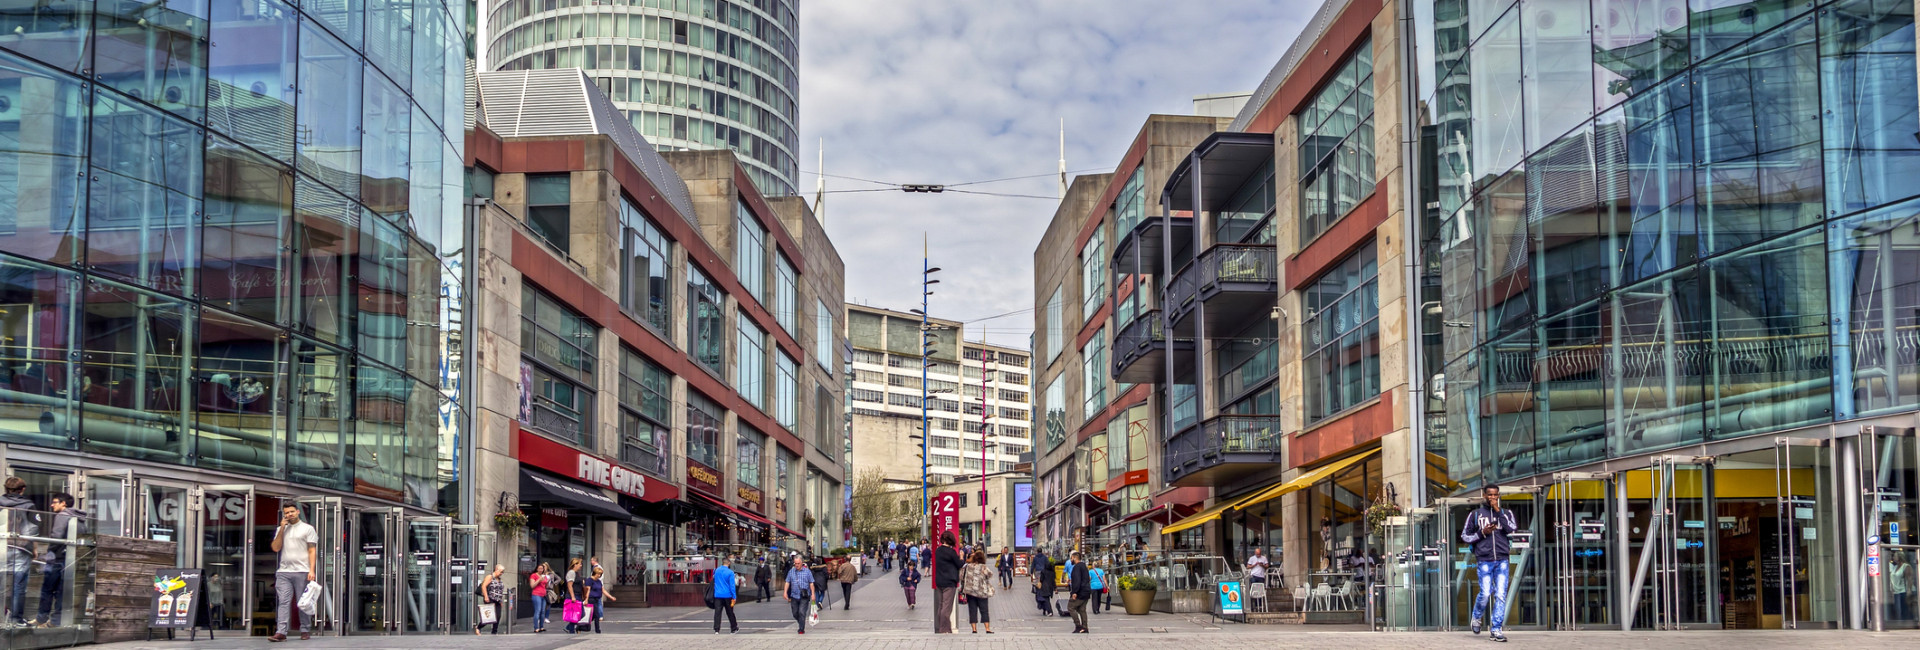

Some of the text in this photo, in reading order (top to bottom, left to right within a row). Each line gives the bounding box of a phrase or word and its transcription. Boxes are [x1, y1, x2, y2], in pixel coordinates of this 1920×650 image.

[578, 453, 611, 486] FIVE
[611, 466, 645, 498] GUYS
[157, 497, 246, 521] GYS
[934, 500, 940, 516] 2
[943, 495, 954, 512] 2
[945, 516, 953, 531] BUL
